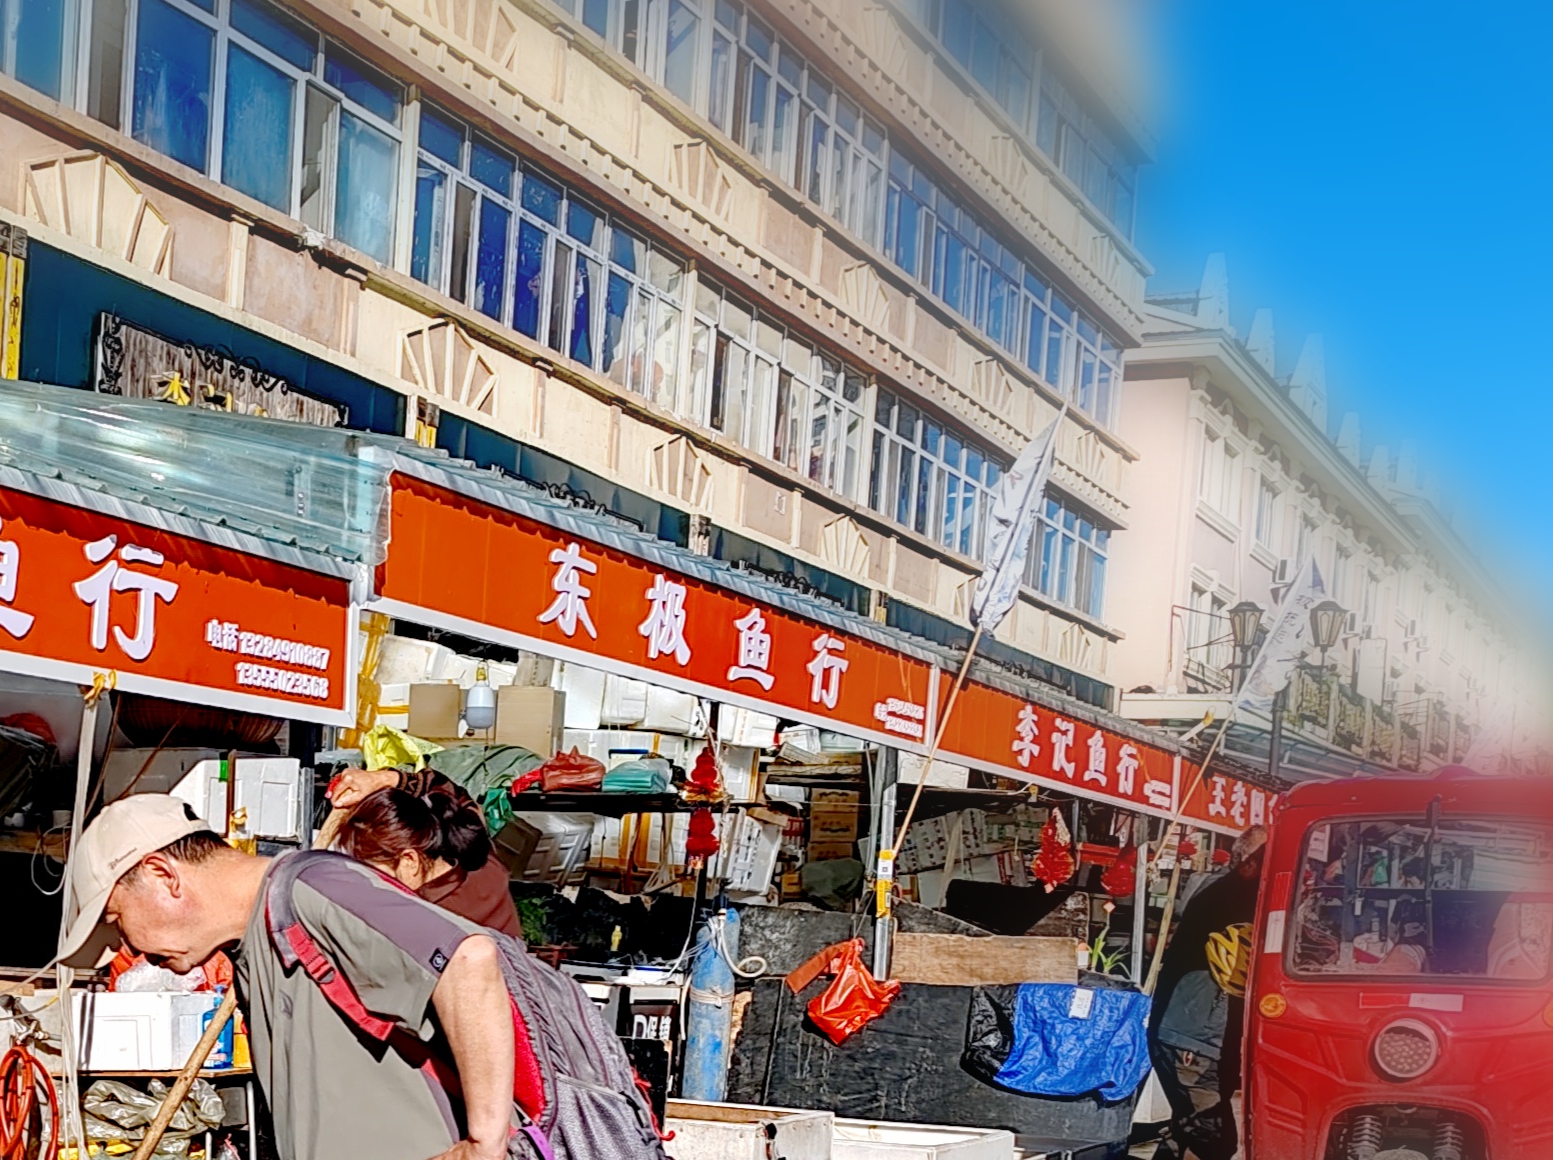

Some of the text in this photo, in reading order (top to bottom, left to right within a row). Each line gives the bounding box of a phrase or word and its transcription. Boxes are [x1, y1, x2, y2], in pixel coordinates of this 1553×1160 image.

[536, 541, 849, 710] 东极鱼行
[1011, 703, 1139, 796] 李记鱼行
